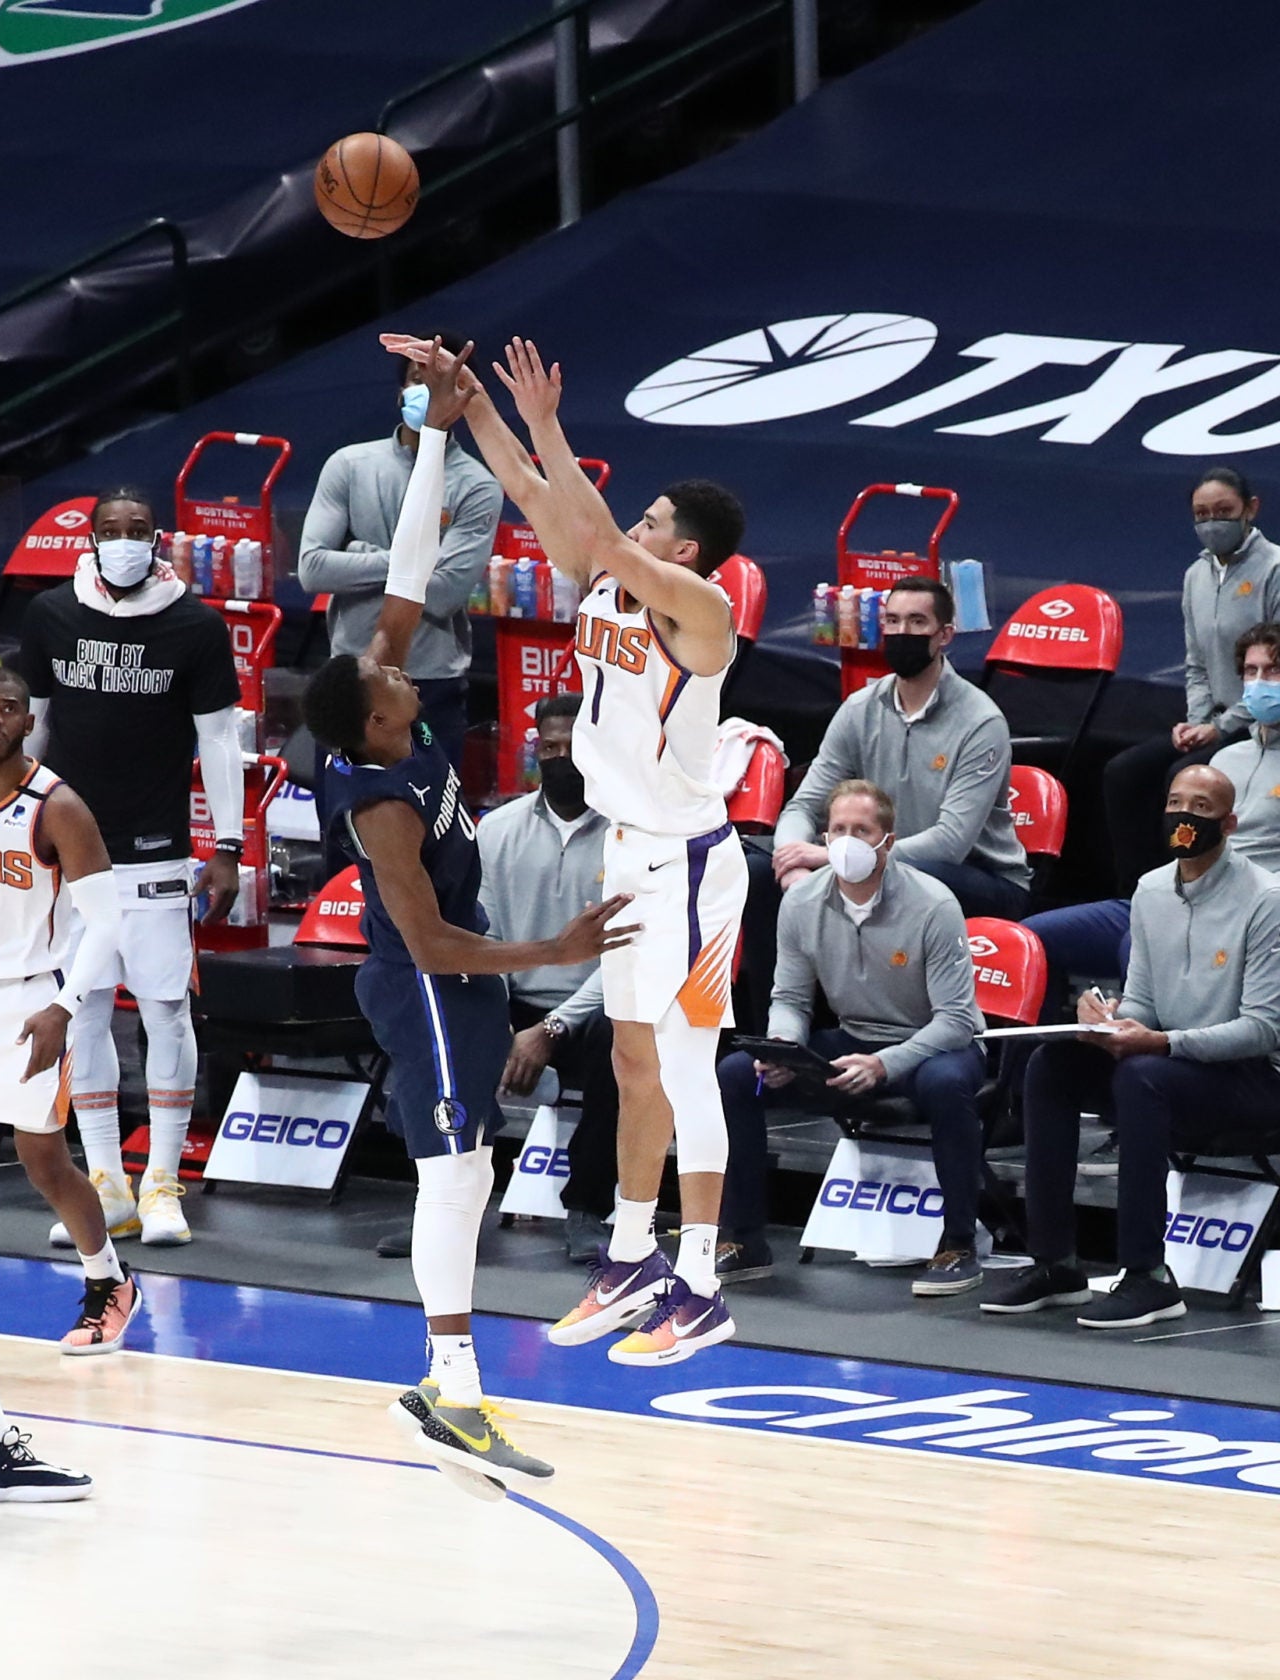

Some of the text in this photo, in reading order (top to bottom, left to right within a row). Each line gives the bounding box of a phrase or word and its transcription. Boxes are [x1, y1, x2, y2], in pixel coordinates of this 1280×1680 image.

[1007, 622, 1090, 642] BIOSTEEL
[77, 638, 145, 667] BUILT BY
[52, 658, 174, 694] BLACK HISTORY
[319, 901, 366, 916] BIOS
[222, 1112, 351, 1149] GEICO
[820, 1178, 946, 1218] GEICO
